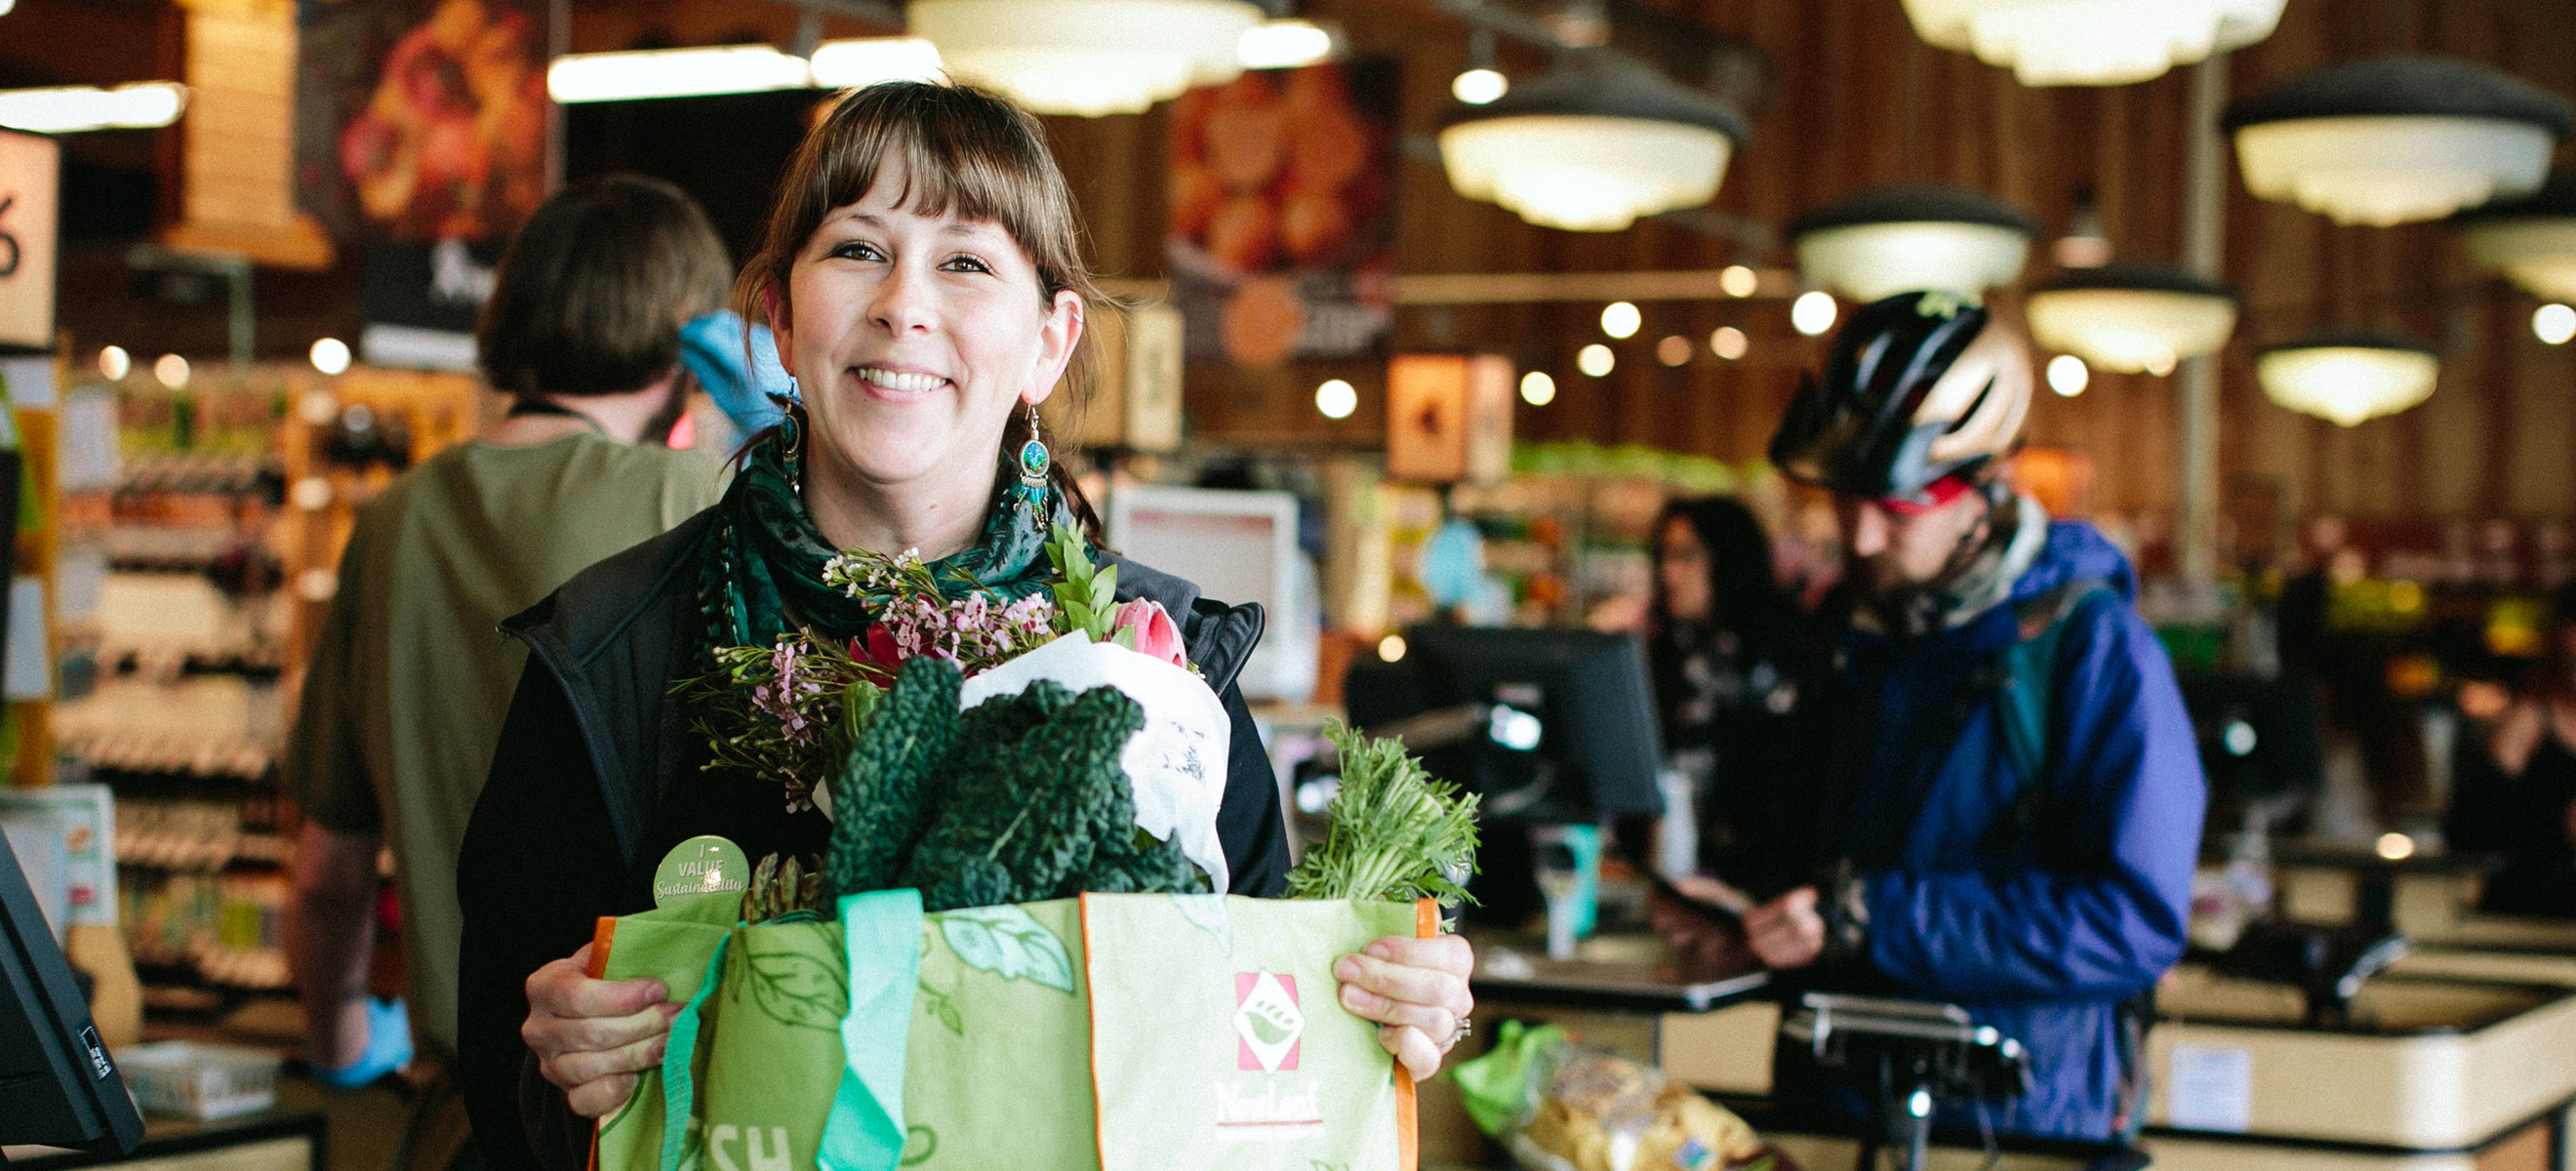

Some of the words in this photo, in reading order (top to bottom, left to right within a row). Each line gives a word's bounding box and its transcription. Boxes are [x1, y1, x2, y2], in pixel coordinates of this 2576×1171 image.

[700, 843, 705, 858] I
[678, 860, 724, 876] VALUE
[704, 1124, 791, 1171] SH
